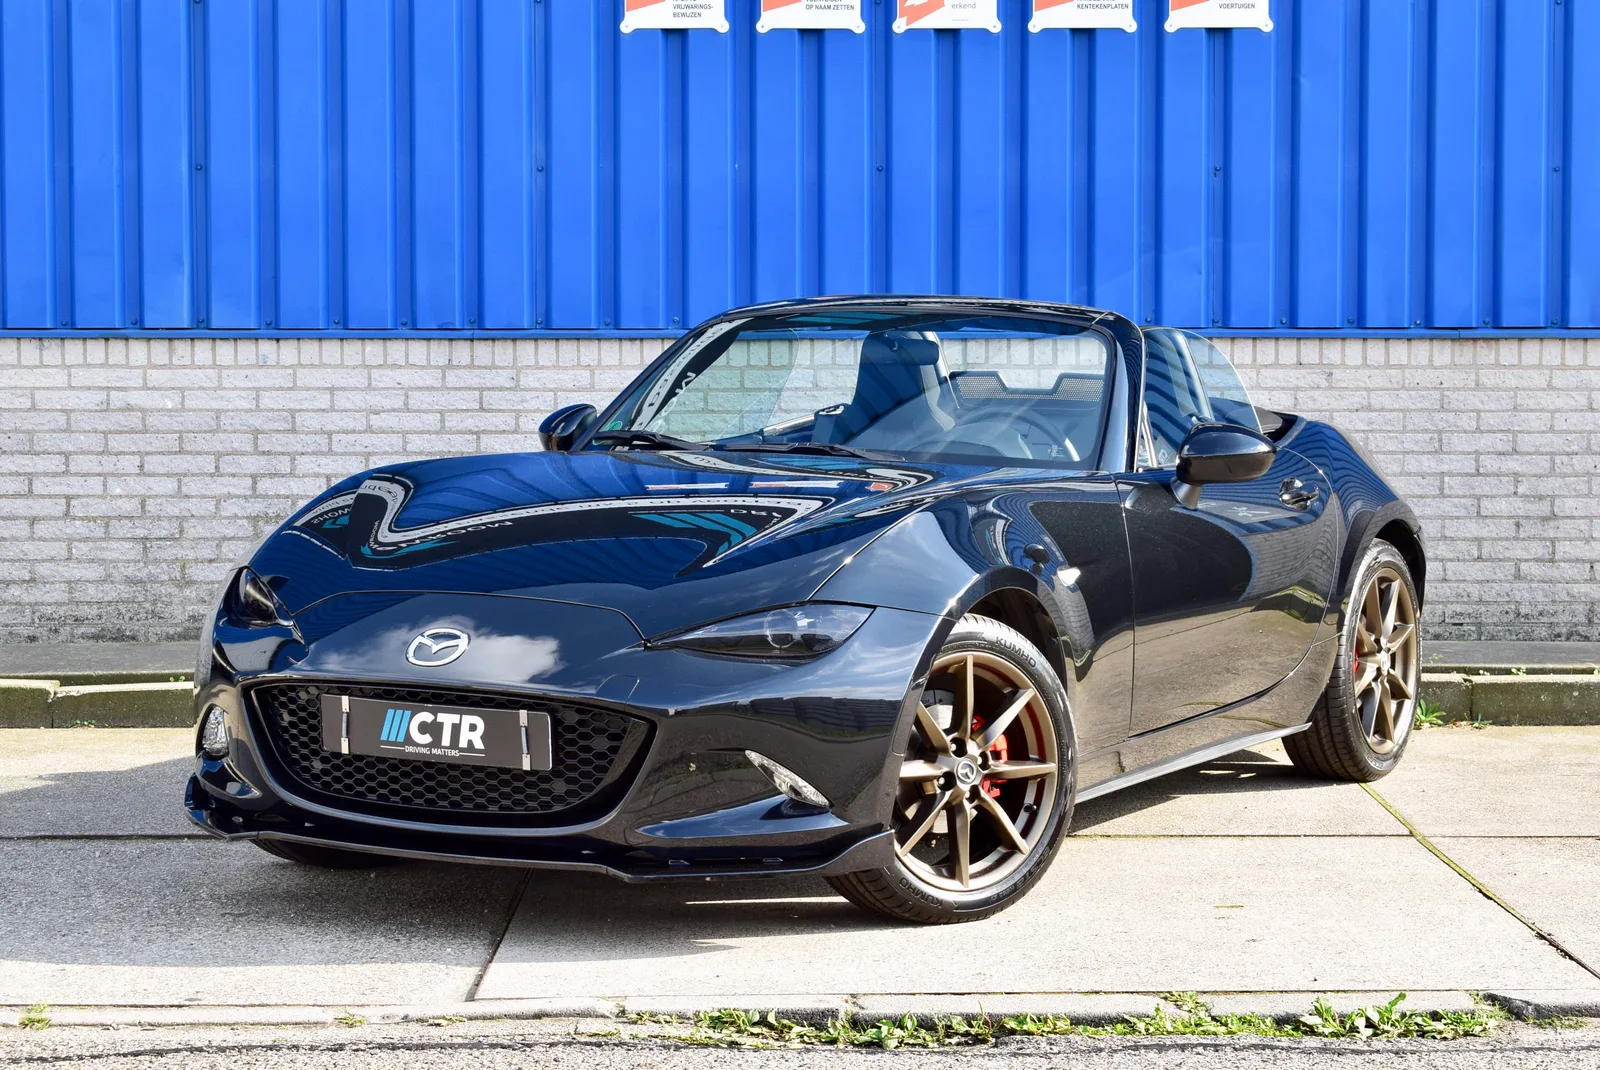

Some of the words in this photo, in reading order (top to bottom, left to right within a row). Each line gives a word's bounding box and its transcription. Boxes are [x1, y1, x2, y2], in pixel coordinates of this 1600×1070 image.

[995, 636, 1037, 668] KUMHO
[409, 711, 485, 750] CTR
[405, 745, 430, 755] DRIVING
[431, 747, 460, 757] MATTERS
[899, 877, 943, 909] KUMHO
